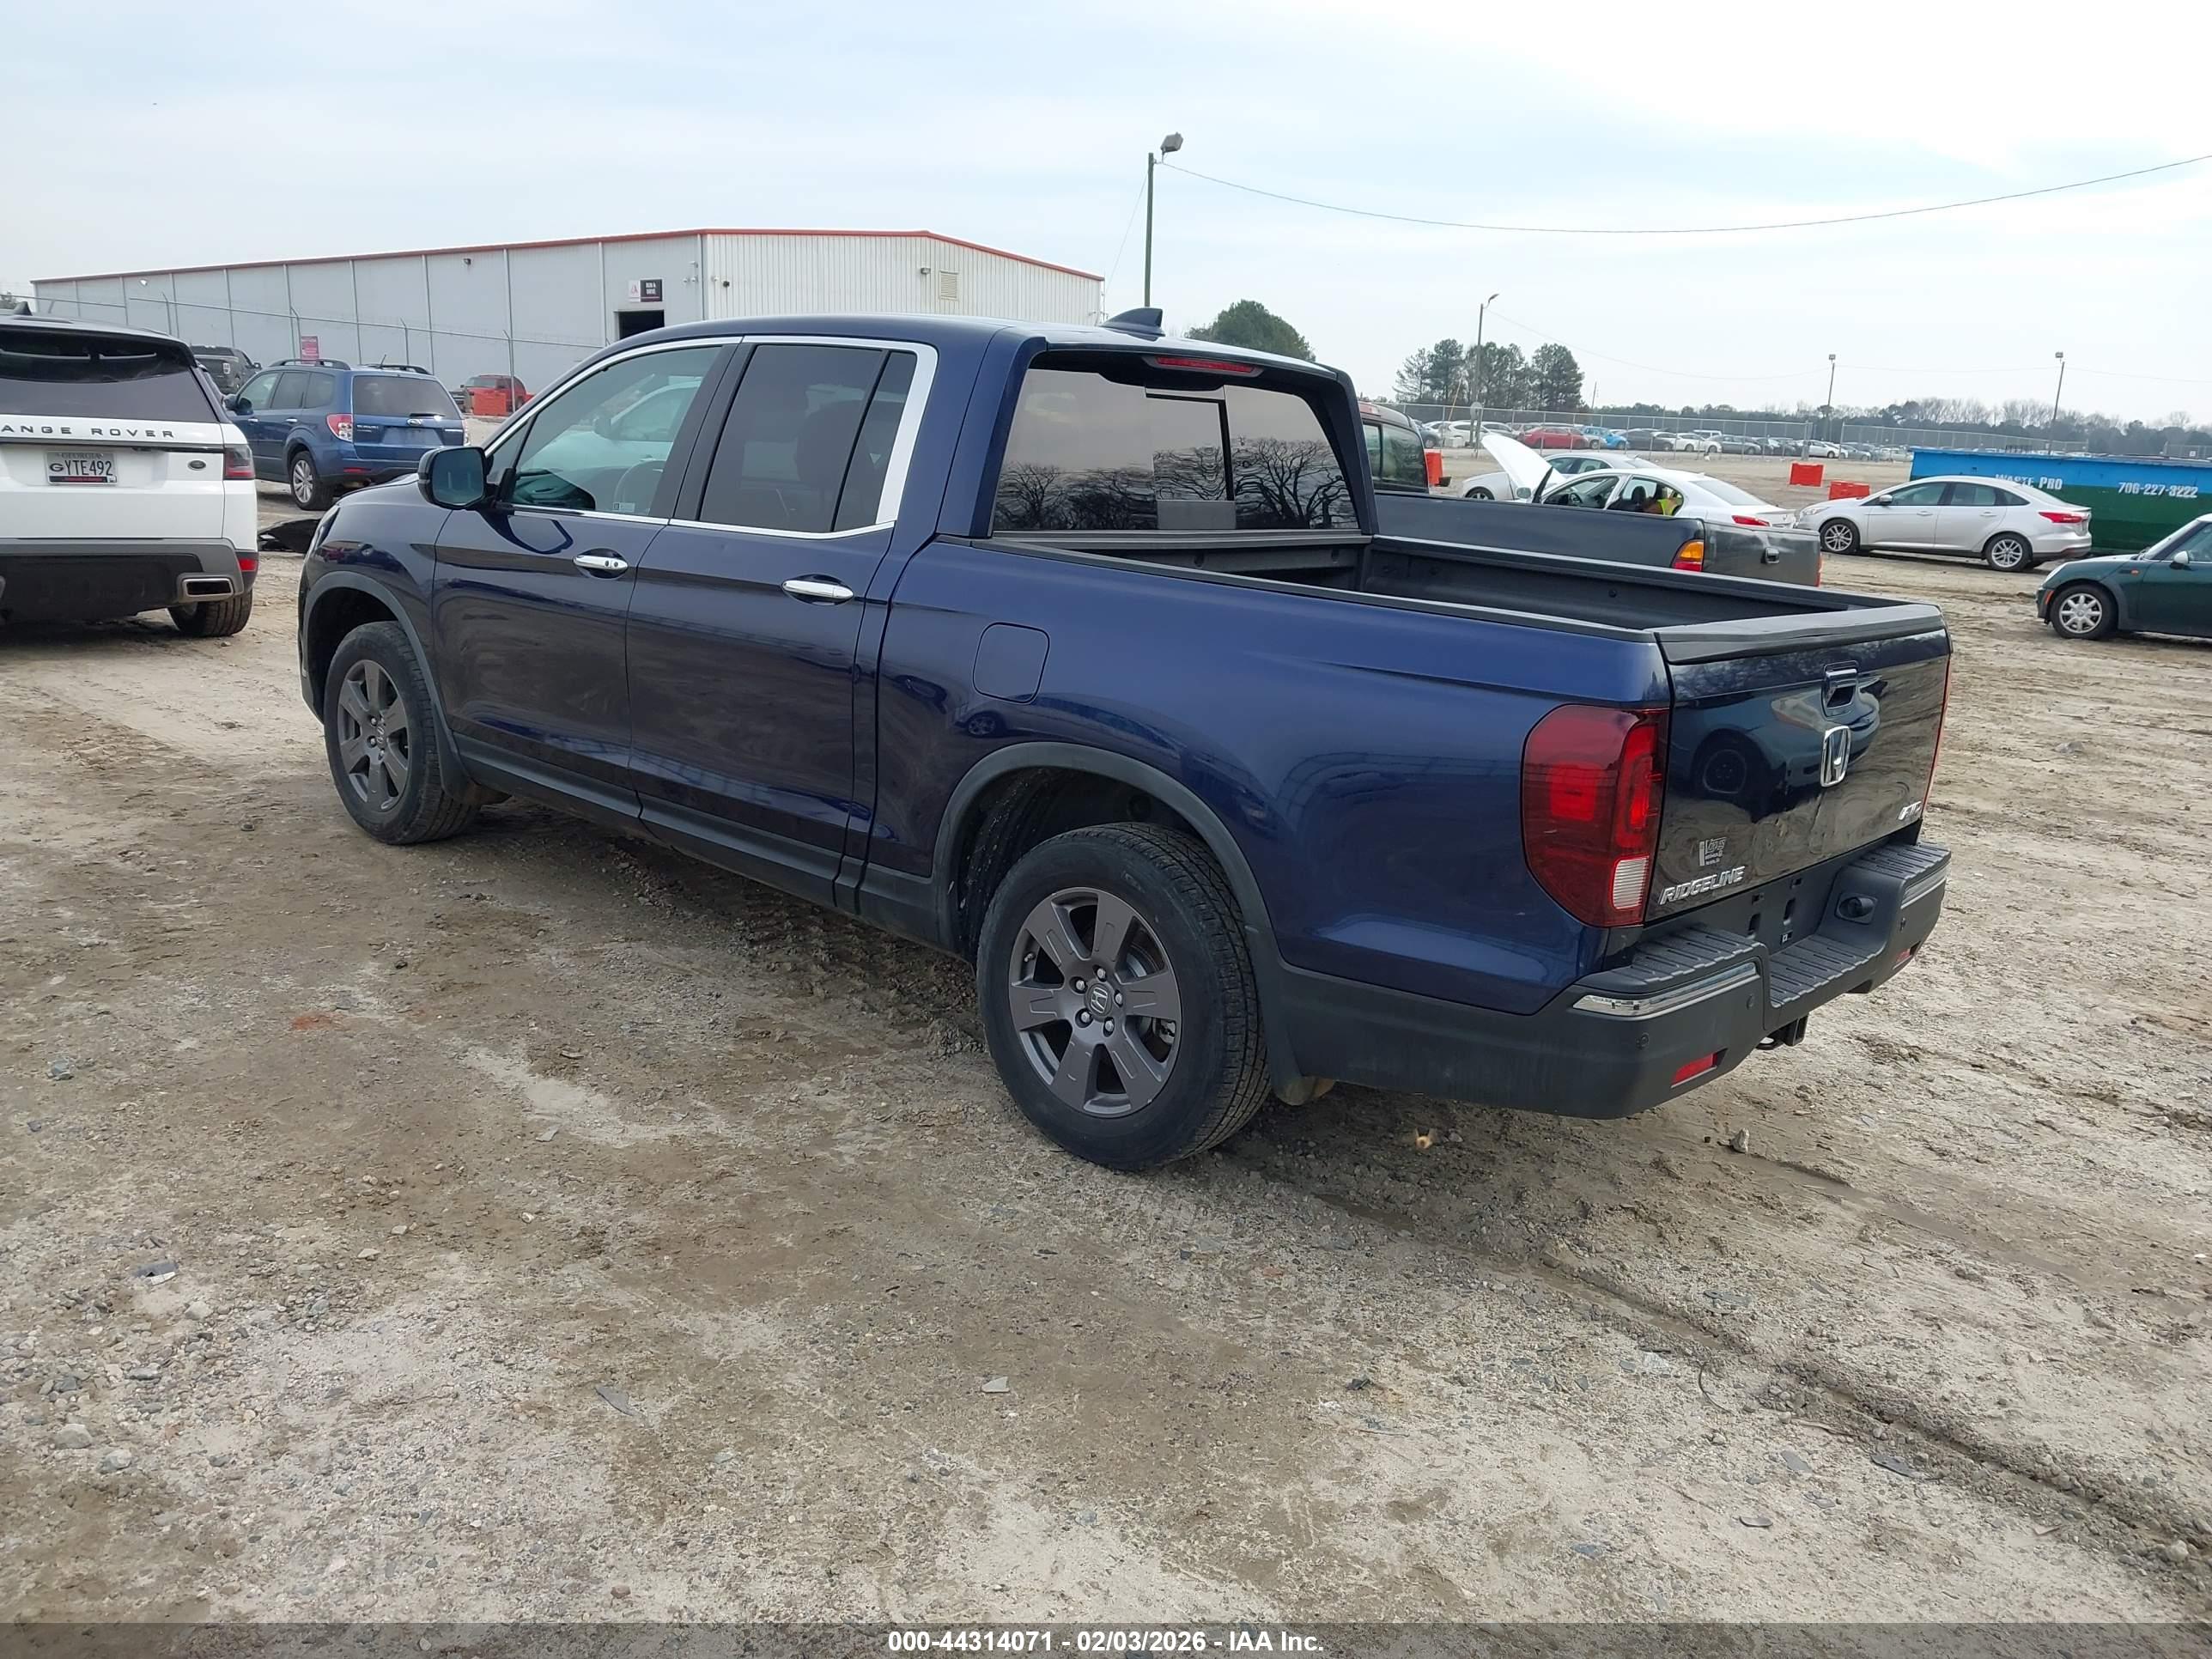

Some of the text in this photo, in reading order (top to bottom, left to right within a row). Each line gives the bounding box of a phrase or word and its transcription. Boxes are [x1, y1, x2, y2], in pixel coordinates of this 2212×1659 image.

[90, 428, 174, 438] ROVER
[64, 459, 113, 476] YTE492
[1658, 866, 1746, 905] RIDGELINE
